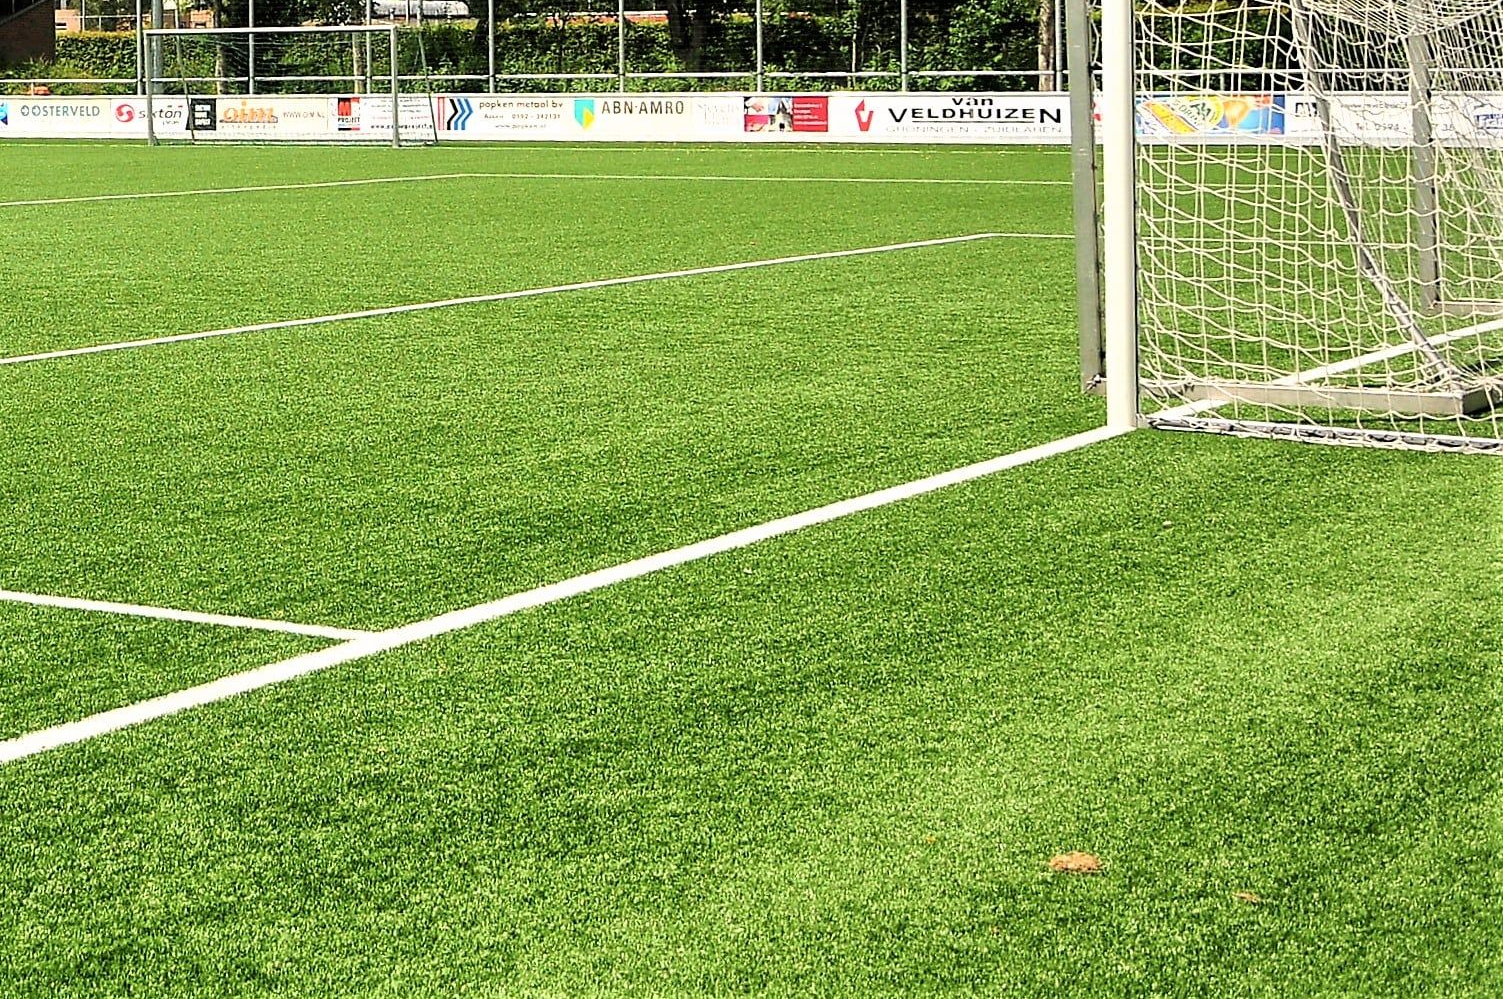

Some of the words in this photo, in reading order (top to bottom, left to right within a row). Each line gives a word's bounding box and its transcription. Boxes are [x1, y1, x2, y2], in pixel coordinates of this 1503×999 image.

[479, 99, 514, 110] popken
[952, 97, 993, 106] van
[20, 105, 100, 117] OOSTERVELD
[139, 105, 183, 119] sxton
[888, 107, 1062, 123] VELDHUIZEN
